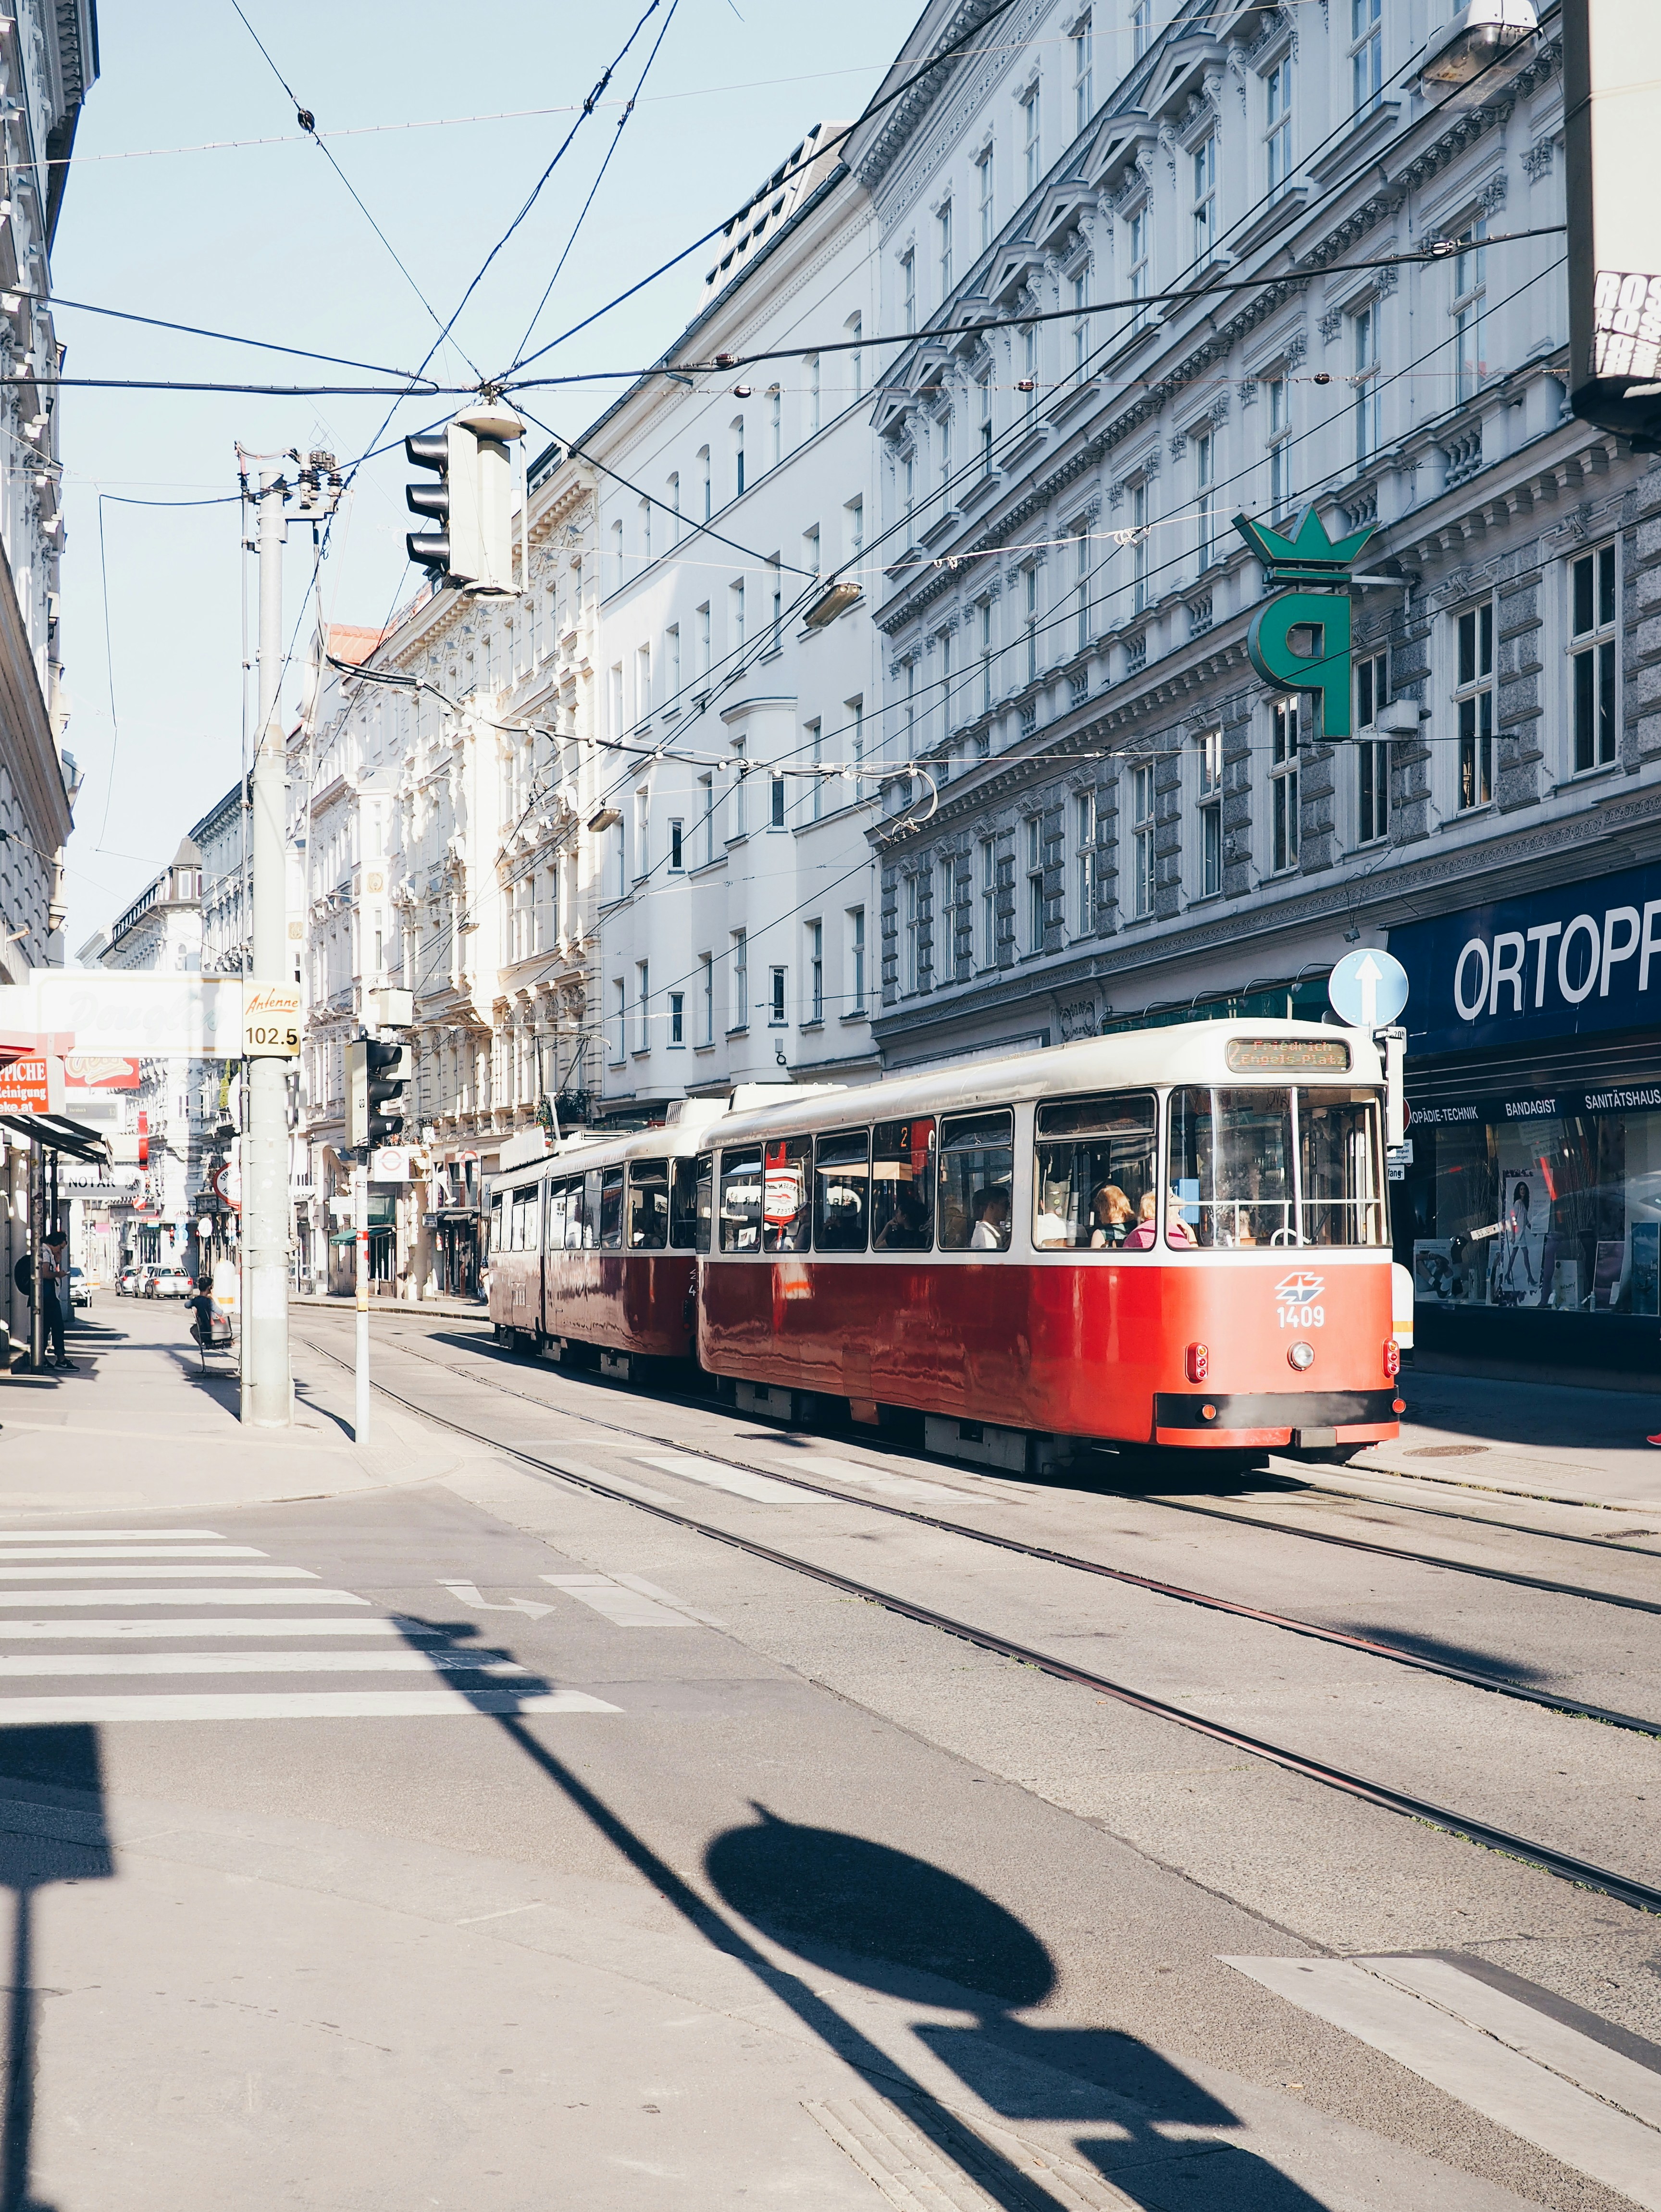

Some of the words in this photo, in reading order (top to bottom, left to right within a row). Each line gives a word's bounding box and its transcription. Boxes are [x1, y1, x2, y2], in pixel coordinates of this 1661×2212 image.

[245, 988, 298, 1015] Antenne
[65, 988, 228, 1044] Douglas
[246, 1027, 297, 1045] 102.5
[0, 1085, 47, 1101] einigung
[1505, 1099, 1556, 1117] BANDAGIST
[1585, 1089, 1661, 1110] SANITÄTSHAUS
[901, 1127, 907, 1147] 2
[69, 1176, 116, 1188] NOTAR
[1277, 1305, 1325, 1328] 1409
